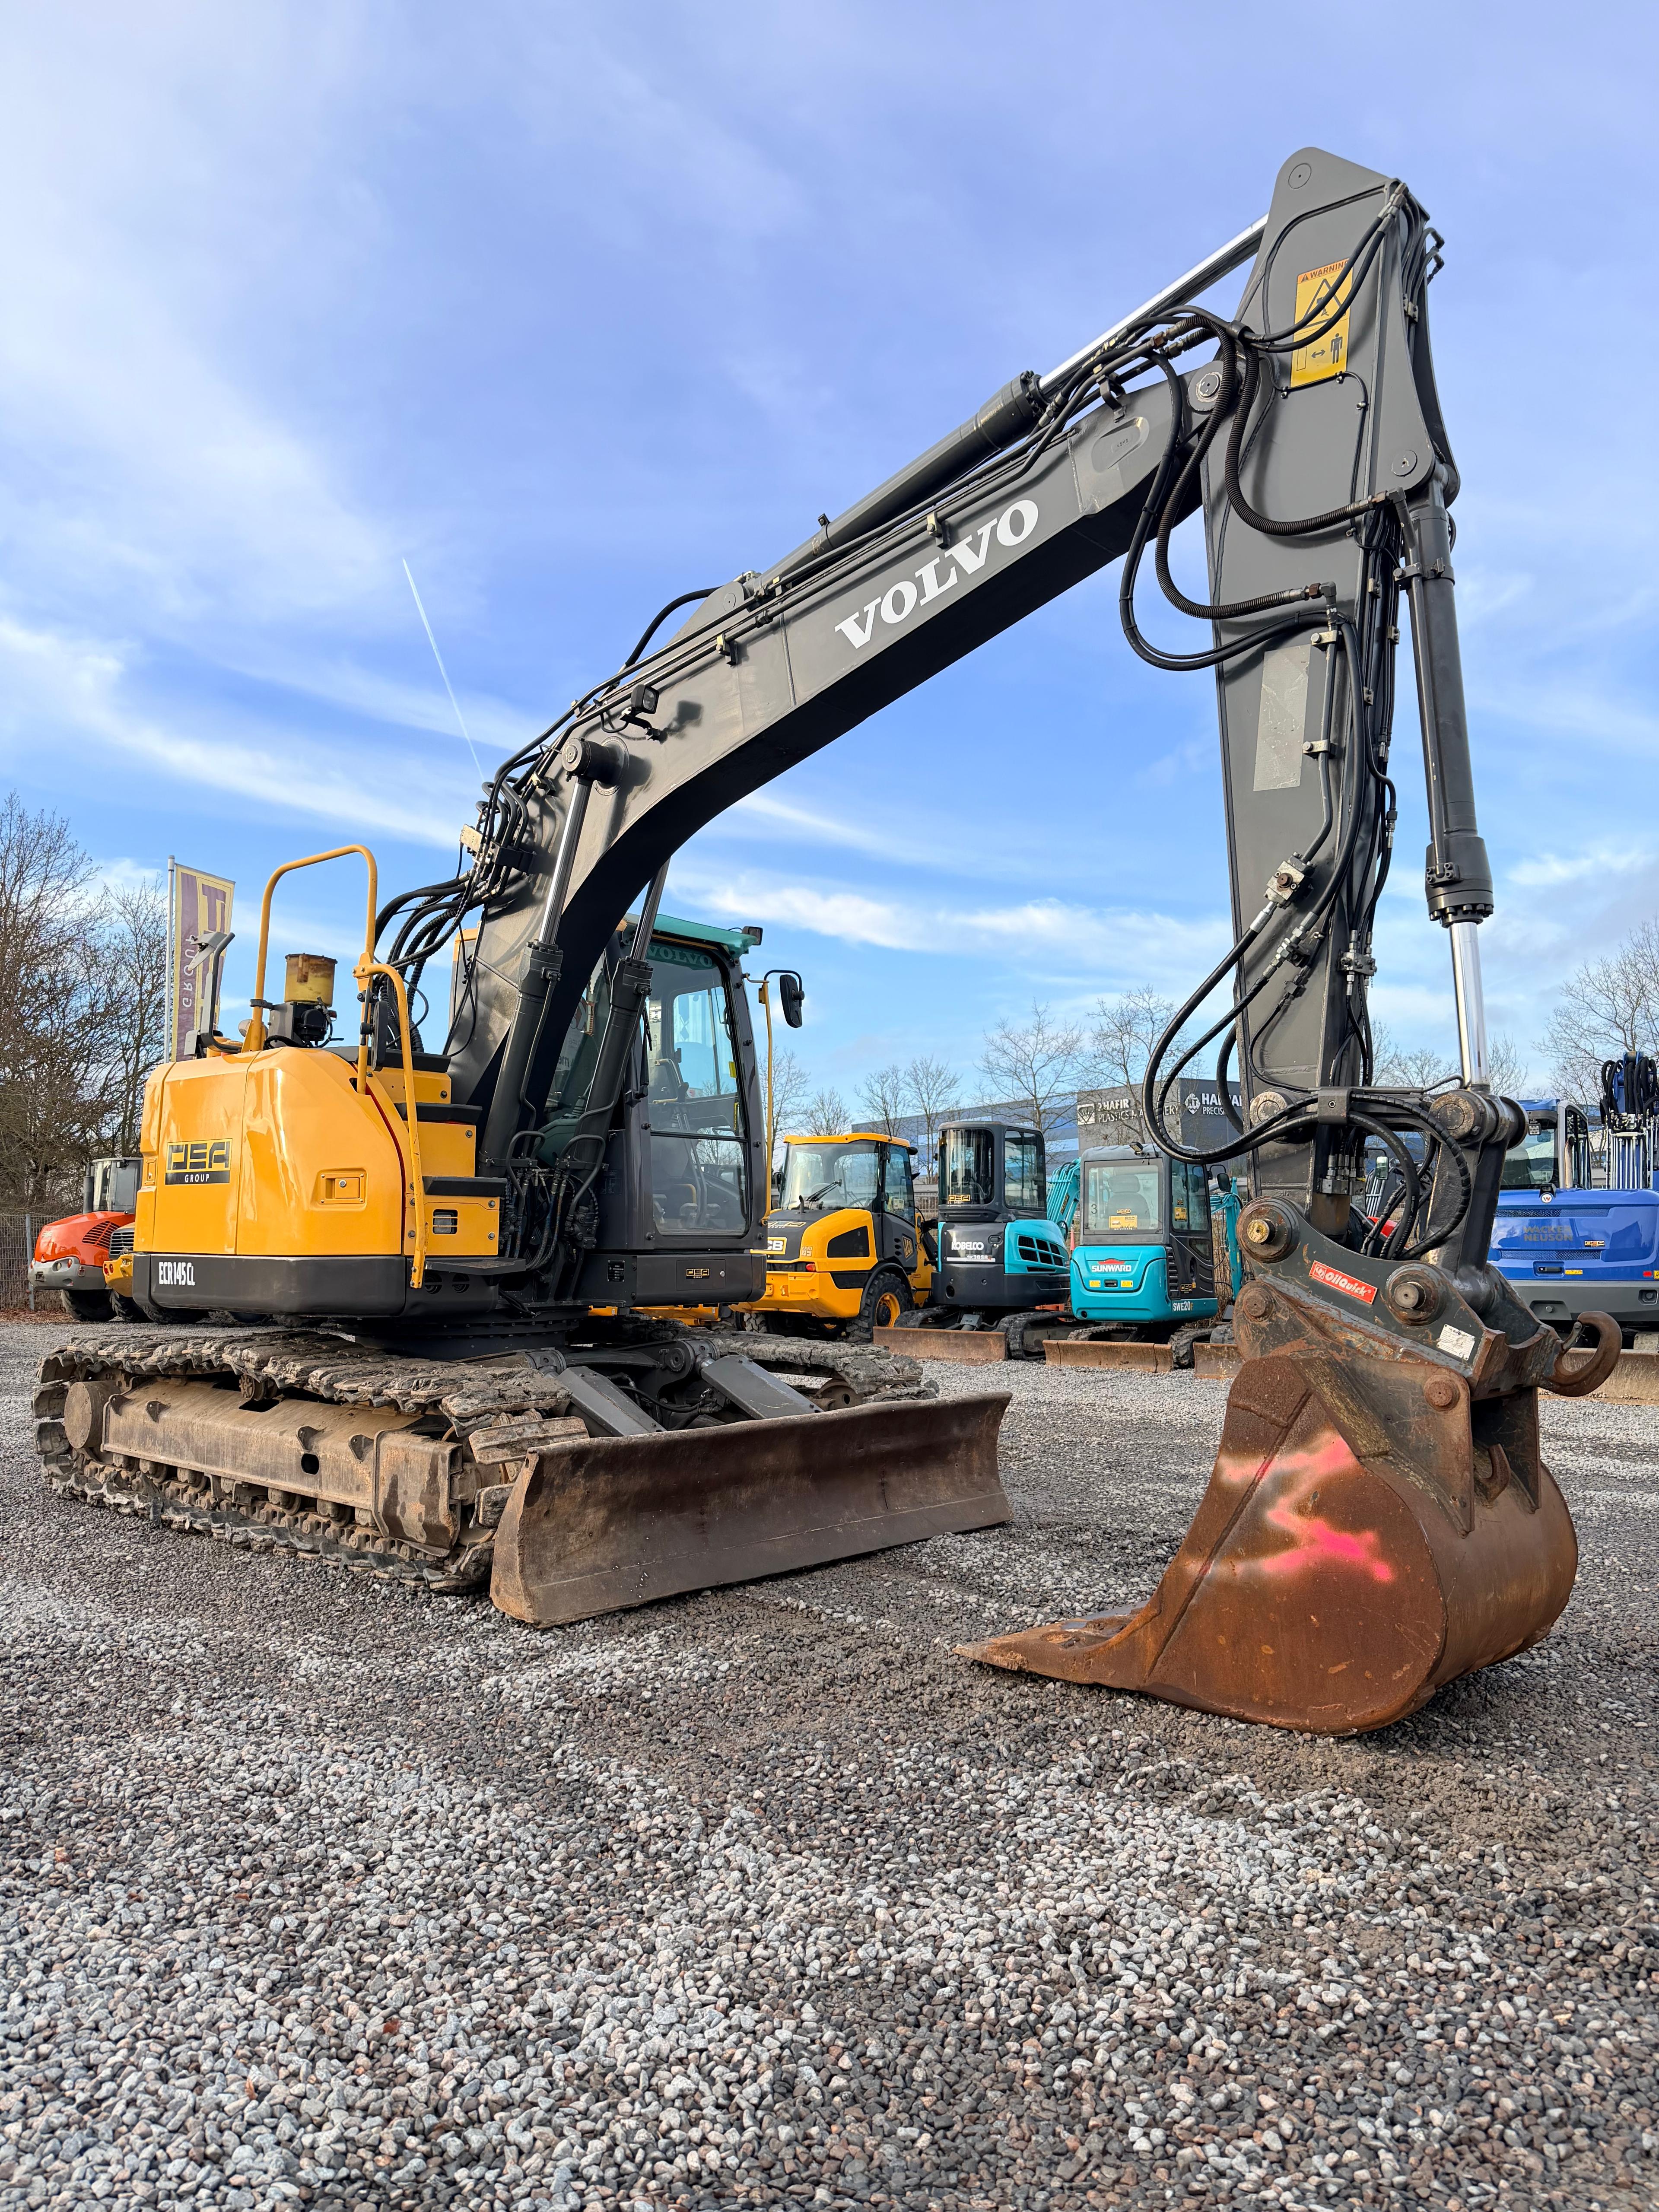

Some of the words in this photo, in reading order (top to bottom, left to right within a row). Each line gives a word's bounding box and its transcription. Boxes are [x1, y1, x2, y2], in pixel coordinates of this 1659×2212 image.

[835, 499, 1039, 649] VOLVO
[648, 945, 713, 967] VOLVO
[184, 1173, 210, 1183] GROUP
[768, 1240, 784, 1250] CB
[951, 1241, 984, 1250] KOBELCO
